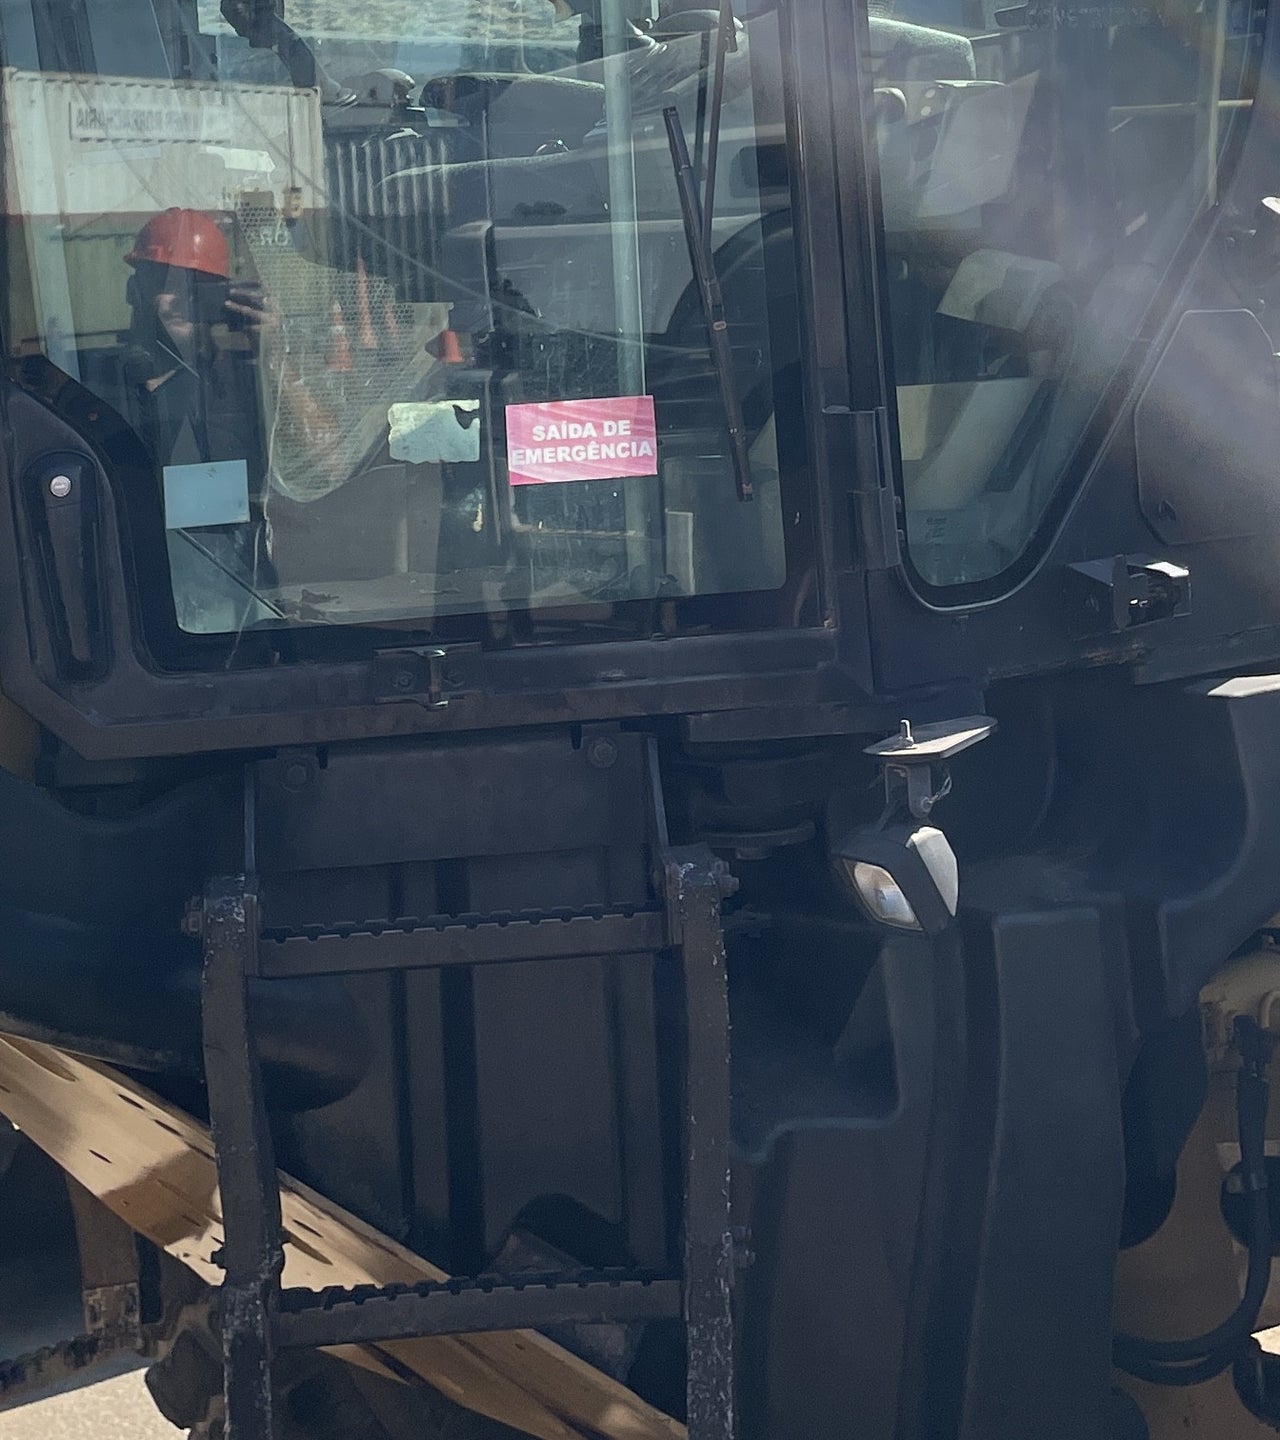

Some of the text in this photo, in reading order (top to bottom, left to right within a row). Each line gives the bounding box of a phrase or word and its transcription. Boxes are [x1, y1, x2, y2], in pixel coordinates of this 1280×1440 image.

[532, 420, 631, 442] SAÍDA DE
[511, 441, 653, 466] EMERGÊNCIA
